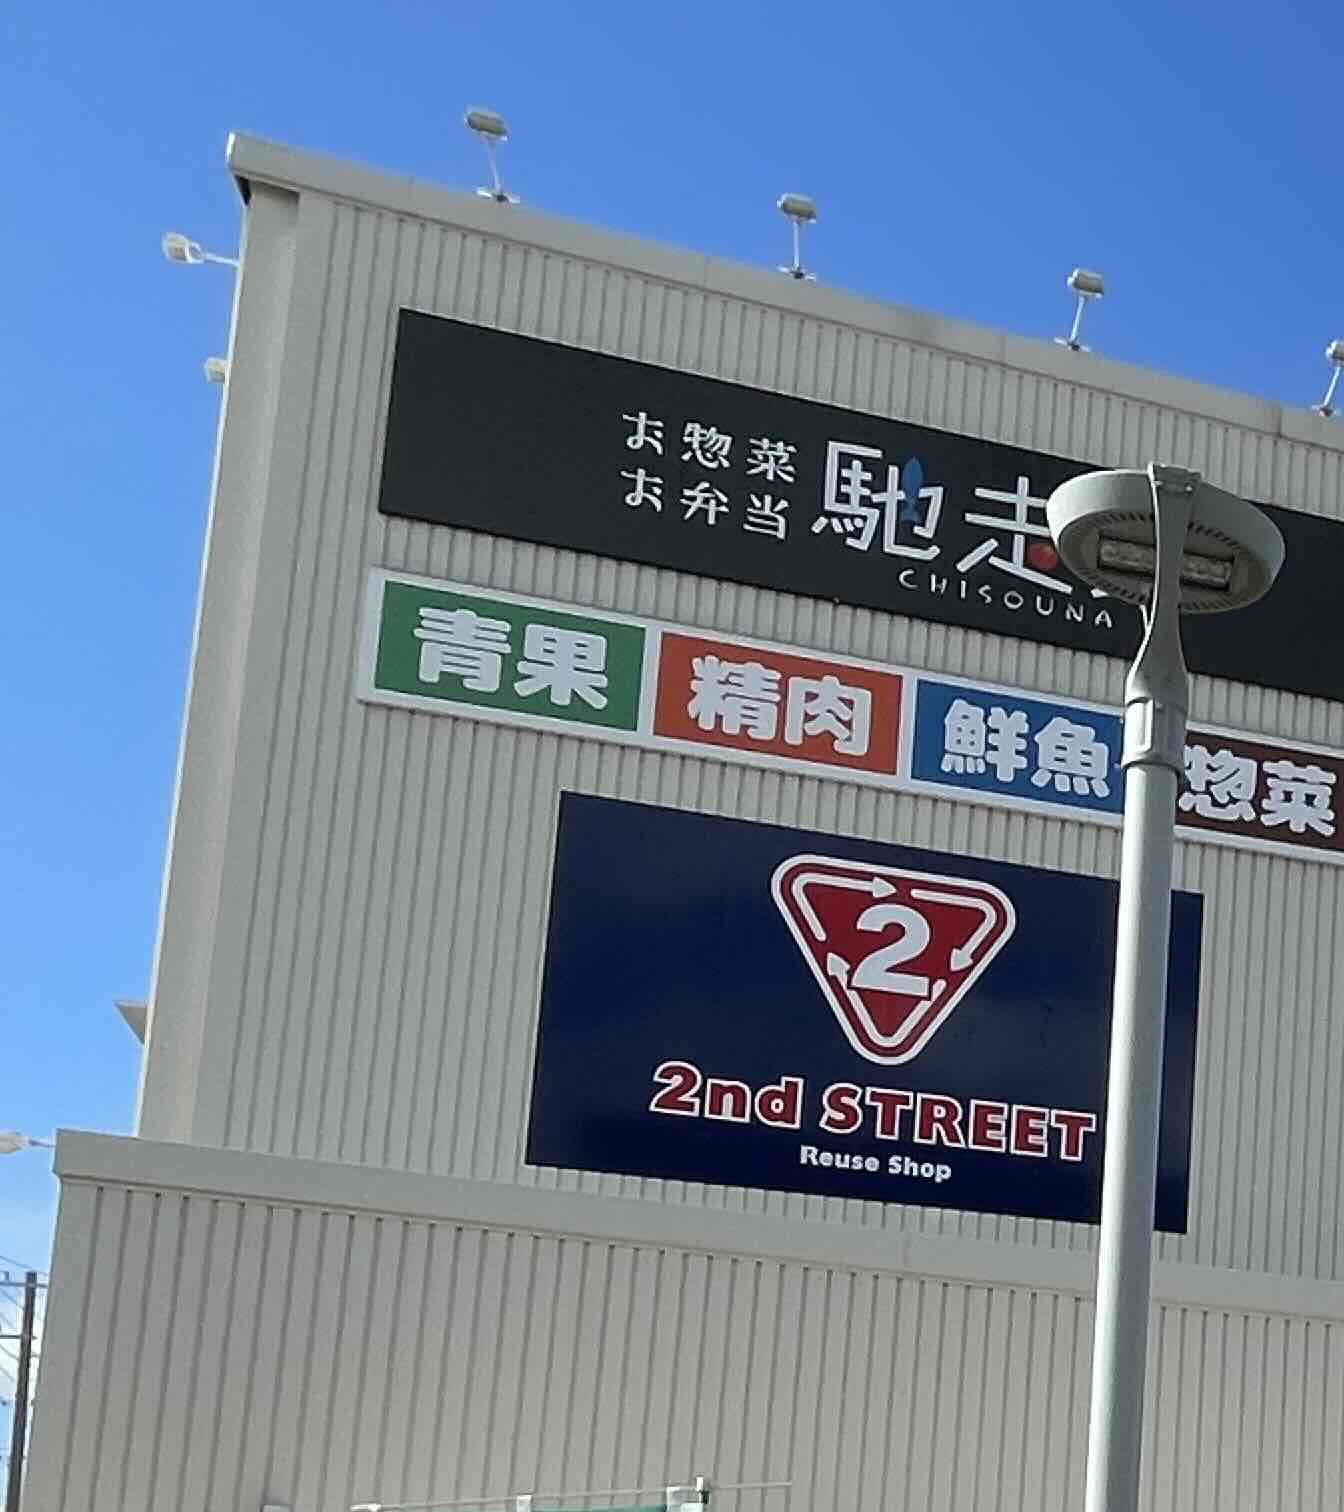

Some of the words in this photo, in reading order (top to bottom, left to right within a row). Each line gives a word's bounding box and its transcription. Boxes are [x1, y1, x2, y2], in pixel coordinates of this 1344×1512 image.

[622, 412, 798, 484] お惣菜
[620, 468, 788, 541] お弁当
[811, 440, 1112, 597] 馳走
[899, 568, 1113, 629] CHISOUNA
[413, 608, 608, 711] 青果
[687, 655, 872, 757] 精肉
[940, 700, 1110, 798] 鮮魚
[1178, 744, 1336, 837] 惣菜
[649, 1060, 806, 1129] 2nd
[820, 1081, 1097, 1162] STREET
[800, 1145, 881, 1176] Reuse
[888, 1154, 953, 1184] Shop
